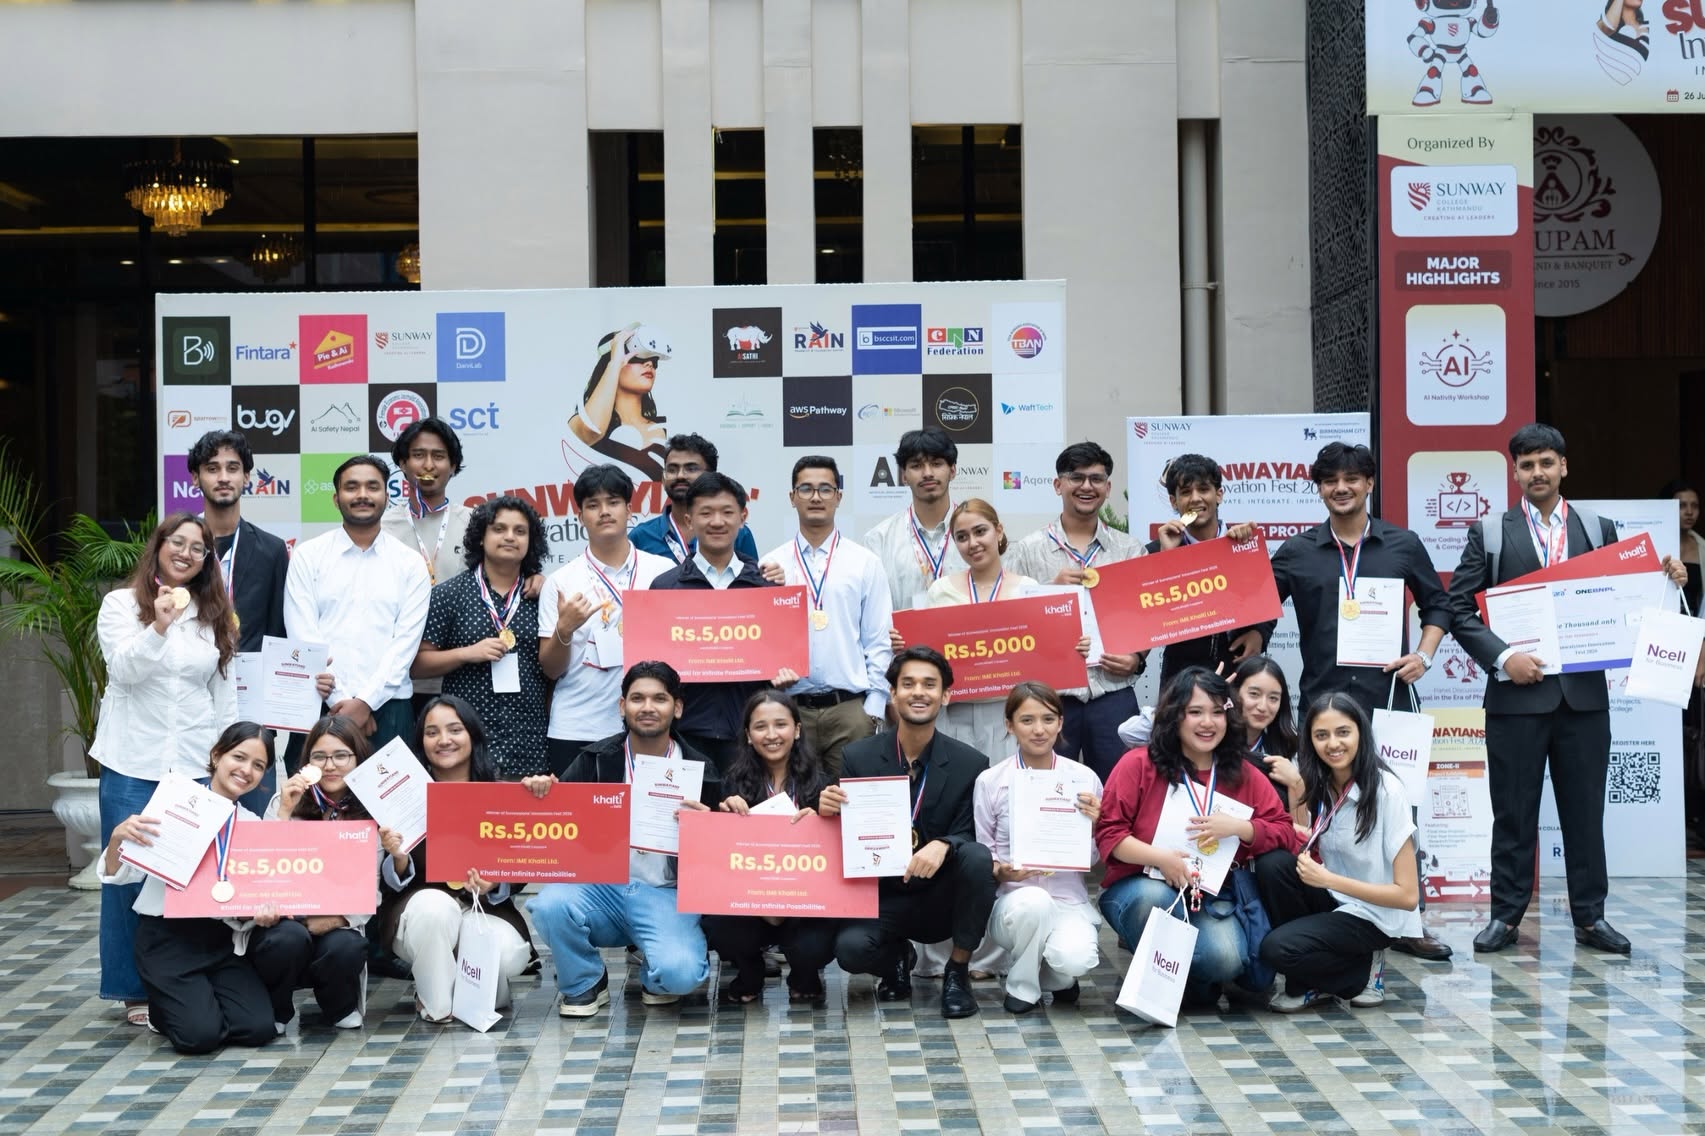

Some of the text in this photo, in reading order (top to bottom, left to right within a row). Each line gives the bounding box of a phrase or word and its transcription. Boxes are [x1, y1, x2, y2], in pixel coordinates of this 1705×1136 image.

[1684, 92, 1695, 100] 26
[1407, 137, 1495, 152] Organized By
[1436, 182, 1506, 197] SUNWAY
[1427, 257, 1479, 269] MAJOR
[1564, 259, 1613, 271] BANQUET
[1406, 272, 1500, 286] HIGHLIGHTS
[1558, 279, 1580, 288] 2015
[391, 332, 432, 341] SUNWAY
[794, 333, 844, 349] RAIN
[874, 335, 915, 343] bsccsit.com
[236, 346, 290, 360] Fintara
[317, 353, 330, 362] Pie
[331, 349, 338, 358] &
[927, 347, 984, 356] Federation
[1443, 356, 1469, 376] AI
[1431, 394, 1456, 402] Nativity
[1457, 394, 1490, 402] Workshop
[450, 402, 500, 430] sct
[790, 405, 847, 416] aws Pathway
[319, 425, 339, 433] Safety
[340, 425, 360, 433] Nepal
[1151, 422, 1192, 431] SUNWAY
[1023, 475, 1053, 486] Aqore
[1271, 480, 1297, 493] Fest
[242, 480, 290, 495] RAIN
[1231, 537, 1259, 553] khalti
[1440, 536, 1461, 545] Coding
[1619, 541, 1647, 561] khalti
[1139, 574, 1228, 609] Rs.5,000
[774, 594, 801, 607] khalti
[1045, 601, 1073, 615] khalti
[1151, 618, 1236, 642] Khalti for Infinite Possibilities
[1565, 618, 1617, 629] Thousand only
[671, 624, 761, 644] Rs.5,000
[944, 635, 1036, 660] Rs.5,000
[1647, 643, 1687, 664] Ncell
[969, 686, 978, 694] for
[1381, 744, 1418, 762] Ncell
[593, 794, 624, 805] khalti
[339, 829, 370, 840] khalti
[479, 821, 578, 842] Rs.5,000
[730, 853, 827, 874] Rs.5,000
[511, 870, 535, 878] Infinite
[462, 958, 481, 980] Ncell
[1153, 950, 1180, 975] Ncell
